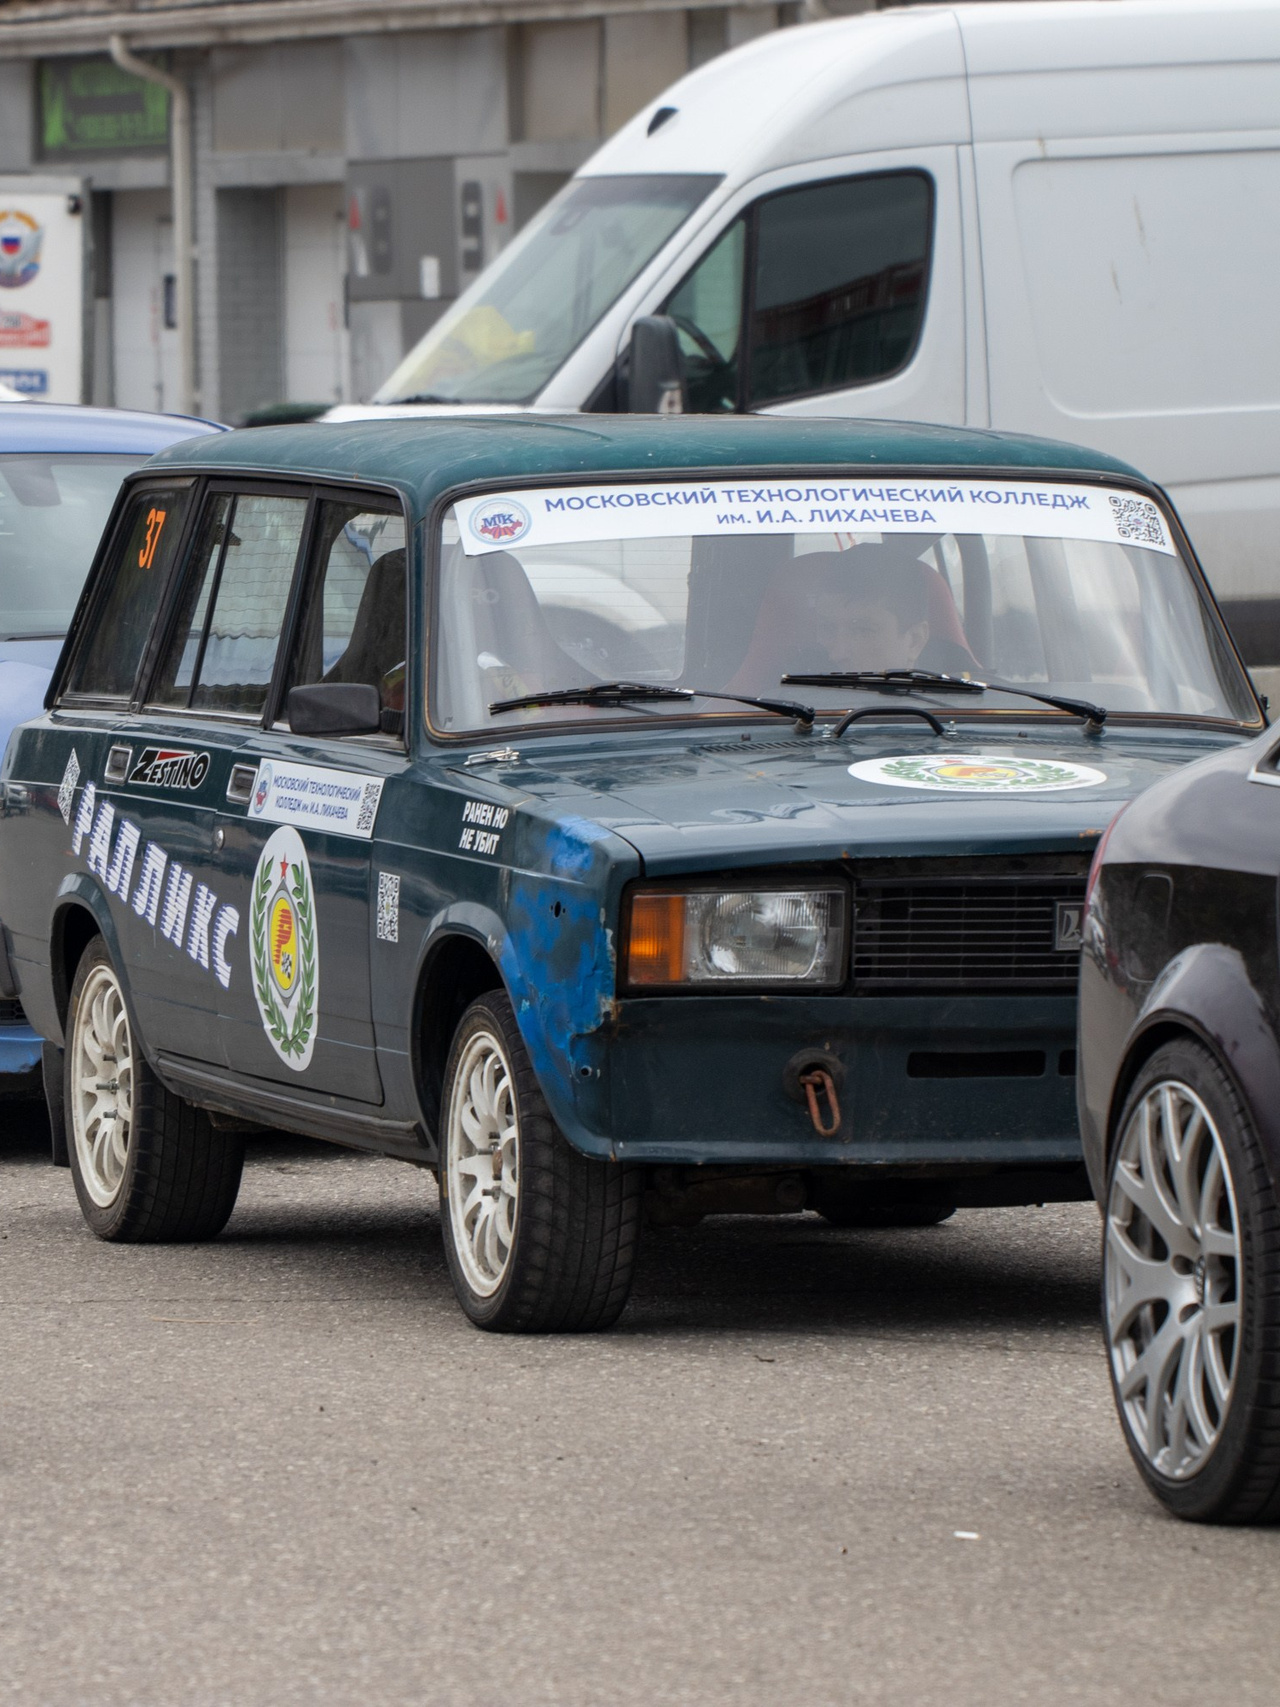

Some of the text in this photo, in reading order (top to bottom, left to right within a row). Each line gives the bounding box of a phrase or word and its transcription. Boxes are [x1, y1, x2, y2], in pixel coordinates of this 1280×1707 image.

[545, 487, 1091, 512] МОСКОВСКИЙ ТЕХНОЛОГИЧЕСКИЙ КОЛЛЕДЖ
[756, 510, 802, 523] И.А.
[809, 509, 936, 523] ЛИХАЧЕВА
[138, 508, 166, 569] 37
[128, 747, 210, 789] ZESTINO
[462, 801, 509, 829] РАНЕН НО
[458, 828, 500, 855] НЕ УБИТ
